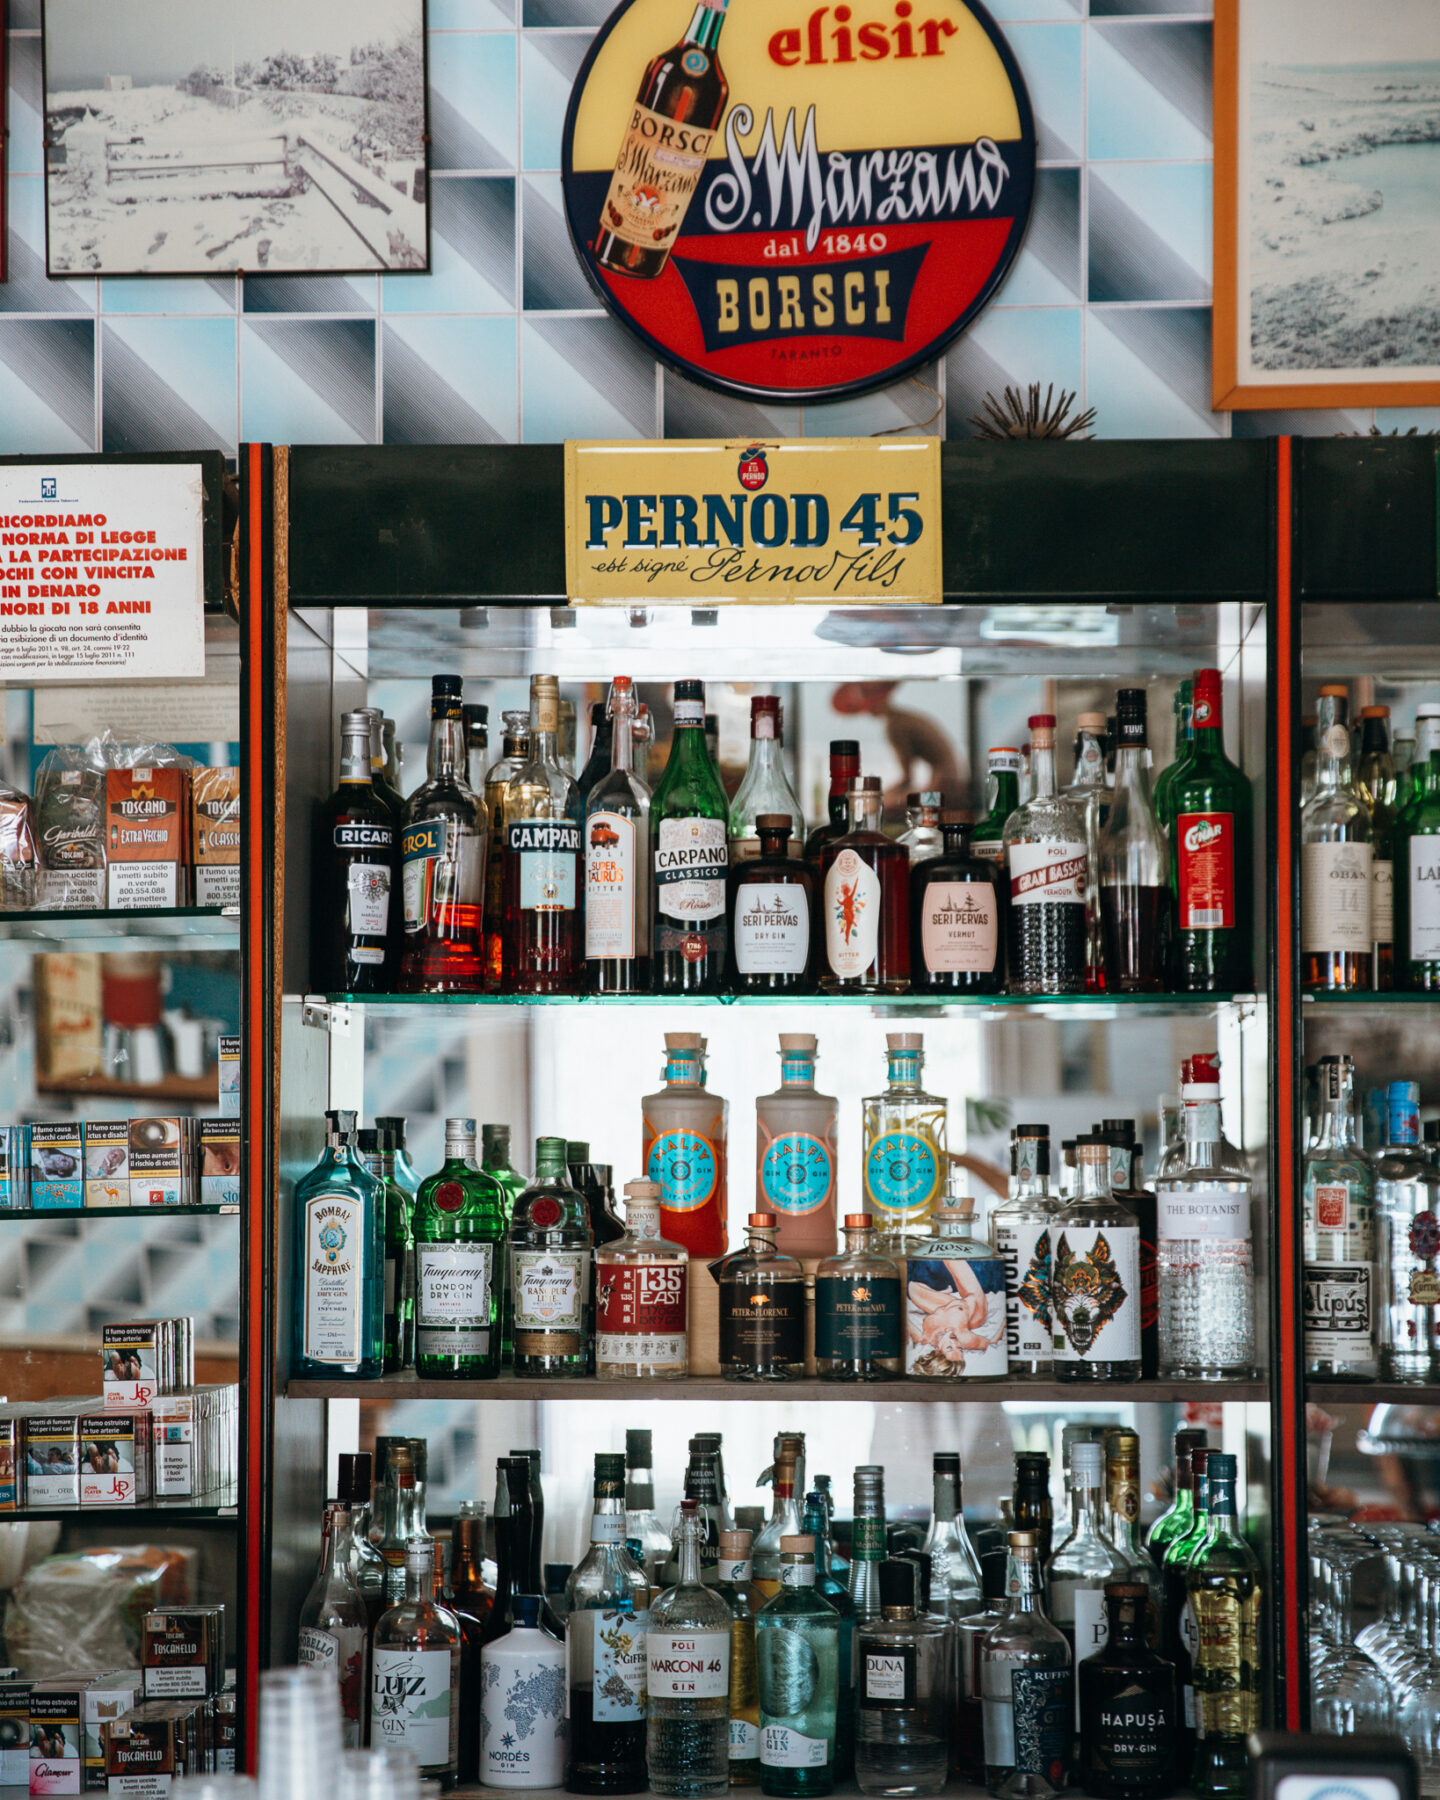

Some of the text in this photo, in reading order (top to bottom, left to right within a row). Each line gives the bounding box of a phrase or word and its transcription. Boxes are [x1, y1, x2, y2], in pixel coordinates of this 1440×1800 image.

[767, 0, 959, 67] elisir
[630, 108, 713, 154] BORSCI
[763, 232, 887, 259] dal 1840
[715, 269, 892, 333] BORSCI
[770, 344, 844, 362] TARANTO
[584, 492, 924, 550] PERNOD 45
[2, 530, 157, 546] NORMA DI LEGGE
[9, 547, 188, 563] LA PARTECIPAZIONE
[40, 566, 78, 580] CON
[84, 565, 156, 580] VINCITA
[590, 557, 627, 573] est
[629, 555, 688, 582] signé
[1, 584, 102, 598] IN DENARO
[51, 602, 71, 616] DI
[78, 601, 100, 615] 18
[105, 600, 152, 615] ANNI
[1, 624, 28, 633] dubbio
[29, 624, 37, 632] la
[38, 625, 67, 635] giocata
[84, 624, 102, 632] sarà
[103, 623, 141, 632] consentita
[9, 634, 48, 643] esibizione
[48, 634, 57, 642] di
[69, 633, 112, 642] documento
[112, 632, 148, 641] d'identità
[21, 645, 37, 654] luglio
[84, 652, 100, 660] luglio
[120, 800, 167, 814] TOSCANO
[43, 823, 97, 844] Garibaldi
[120, 829, 169, 844] EXTRA VECCHIO
[511, 827, 582, 849] CAMPARI
[1184, 824, 1222, 852] CYNAR
[658, 846, 727, 868] CARPANO
[1047, 848, 1068, 856] POLI
[591, 861, 616, 871] SUPER
[116, 871, 169, 879] smetti subito
[588, 867, 624, 883] TAURUS
[665, 867, 719, 881] CLASSICO
[1018, 868, 1047, 892] GRAN
[1329, 870, 1368, 880] OBAN
[117, 896, 130, 904] per
[742, 915, 799, 927] SERI PERVAS
[932, 913, 989, 925] SERI PERVAS
[754, 932, 786, 940] DRY GIN
[32, 1133, 56, 1141] attacchi
[87, 1131, 102, 1139] ictus
[135, 1152, 151, 1160] fumo
[653, 1137, 710, 1162] MALFY
[768, 1141, 825, 1165] MALFY
[873, 1138, 929, 1163] MALFY
[135, 1159, 163, 1167] rischio di
[314, 1205, 352, 1224] BOMBAY
[628, 1212, 655, 1220] KAIKYO
[1166, 1204, 1241, 1216] THE BOTANIST
[311, 1258, 352, 1276] SAPPHIRE
[423, 1263, 483, 1281] Tanqueray
[430, 1283, 473, 1291] LONDON
[430, 1291, 473, 1299] DRY GIN
[640, 1291, 681, 1305] EAST
[731, 1307, 789, 1317] PETER FLORENCE
[835, 1303, 887, 1313] PETER NAVY
[126, 1327, 152, 1335] ostruisce
[122, 1335, 142, 1343] arterie
[153, 1643, 197, 1656] TOSCANELLO
[671, 1642, 695, 1650] POLI
[650, 1659, 722, 1673] MARCONI 46
[867, 1658, 904, 1672] DUNA
[373, 1674, 426, 1696] LUZ
[672, 1682, 695, 1691] GIN
[382, 1718, 406, 1731] GIN
[766, 1728, 789, 1741] LUZ
[766, 1739, 789, 1751] GIN
[116, 1749, 163, 1763] TOSCANELLO
[489, 1750, 530, 1762] NORDÉS
[34, 1762, 74, 1778] Glamour
